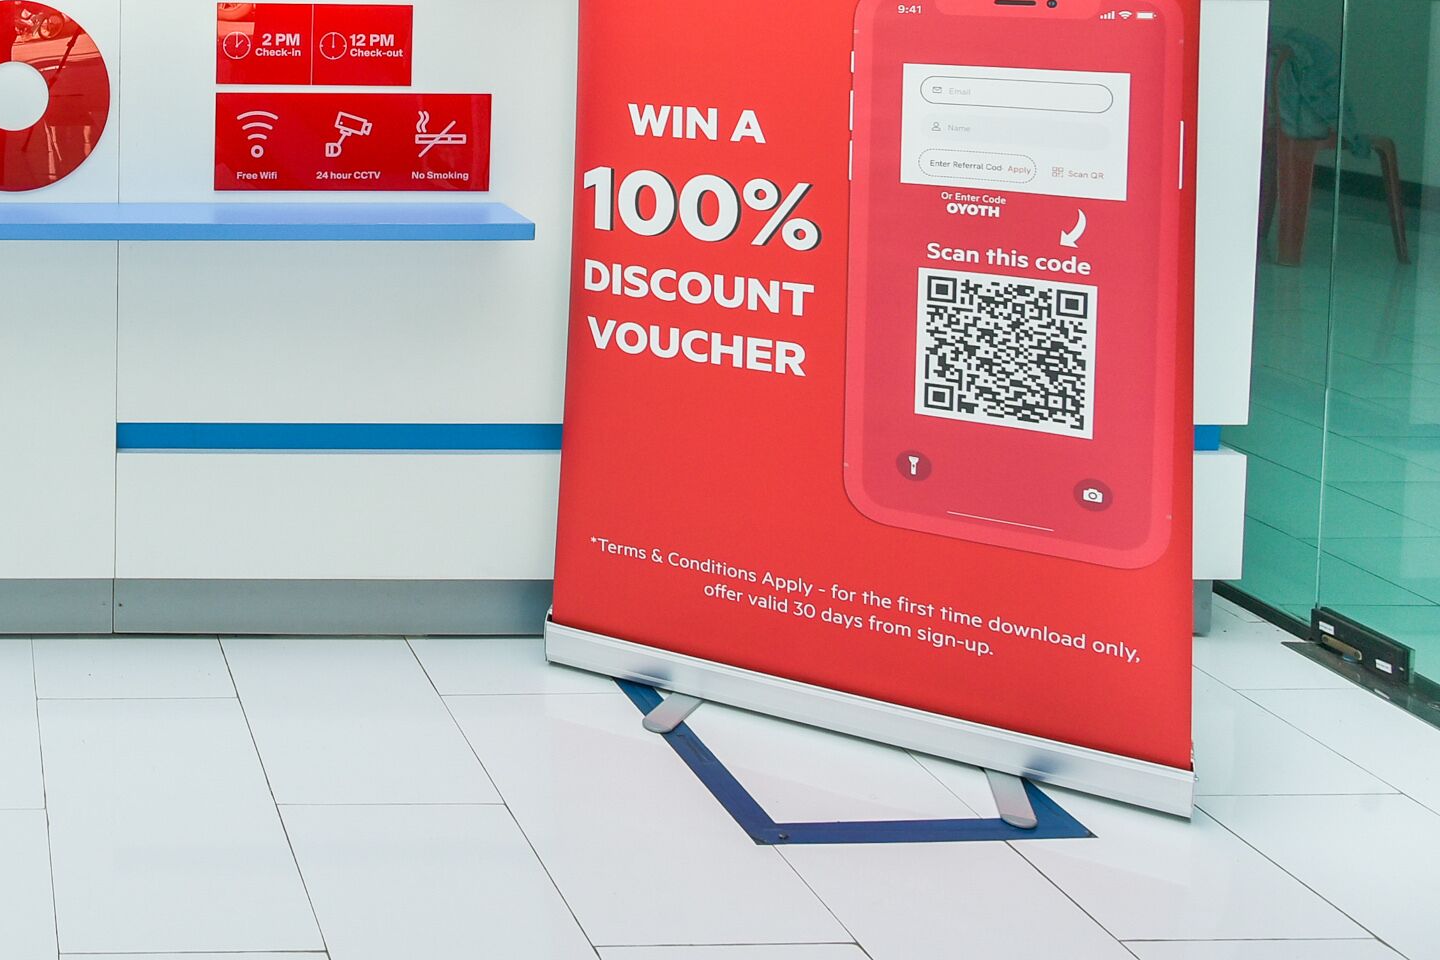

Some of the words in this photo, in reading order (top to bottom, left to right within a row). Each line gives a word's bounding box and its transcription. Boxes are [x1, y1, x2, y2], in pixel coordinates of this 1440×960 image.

[897, 4, 922, 14] 9:41
[262, 34, 272, 46] 2
[275, 34, 300, 46] PM
[349, 34, 364, 46] 12
[369, 34, 394, 46] PM
[255, 47, 301, 57] Check-in
[350, 48, 403, 57] Check-out
[949, 88, 971, 96] Email
[628, 103, 718, 141] WIN
[730, 109, 766, 144] A
[930, 160, 950, 168] Enter
[953, 161, 984, 170] Referral
[1008, 166, 1031, 175] Apply
[236, 171, 258, 180] Free
[260, 171, 277, 180] Wifi
[316, 171, 329, 180] 24
[330, 171, 352, 180] hour
[353, 171, 380, 180] CCTV
[412, 171, 425, 180] No
[427, 171, 469, 181] Smoking
[1068, 171, 1088, 179] Scan
[1091, 171, 1104, 180] QR
[941, 191, 953, 200] Or
[955, 192, 980, 202] Enter
[982, 194, 1006, 205] Code
[583, 166, 822, 251] 100%
[946, 202, 1000, 217] OYOTH
[927, 242, 980, 264] Scan
[986, 247, 1029, 268] this
[1035, 253, 1091, 276] code
[584, 258, 815, 317] DISCOUNT
[587, 315, 807, 377] VOUCHER
[651, 548, 663, 564] &
[668, 552, 757, 582] Conditions
[762, 571, 813, 596] Apply
[831, 584, 856, 602] for
[862, 591, 892, 609] the
[897, 596, 935, 618] first
[940, 606, 982, 628] time
[988, 616, 1086, 650] download
[1092, 640, 1141, 664] only,
[704, 584, 743, 602] offer
[748, 591, 788, 613] valid
[793, 601, 815, 619] 30
[821, 607, 863, 630] days
[868, 615, 911, 638] from
[917, 627, 994, 656] sign-up.
